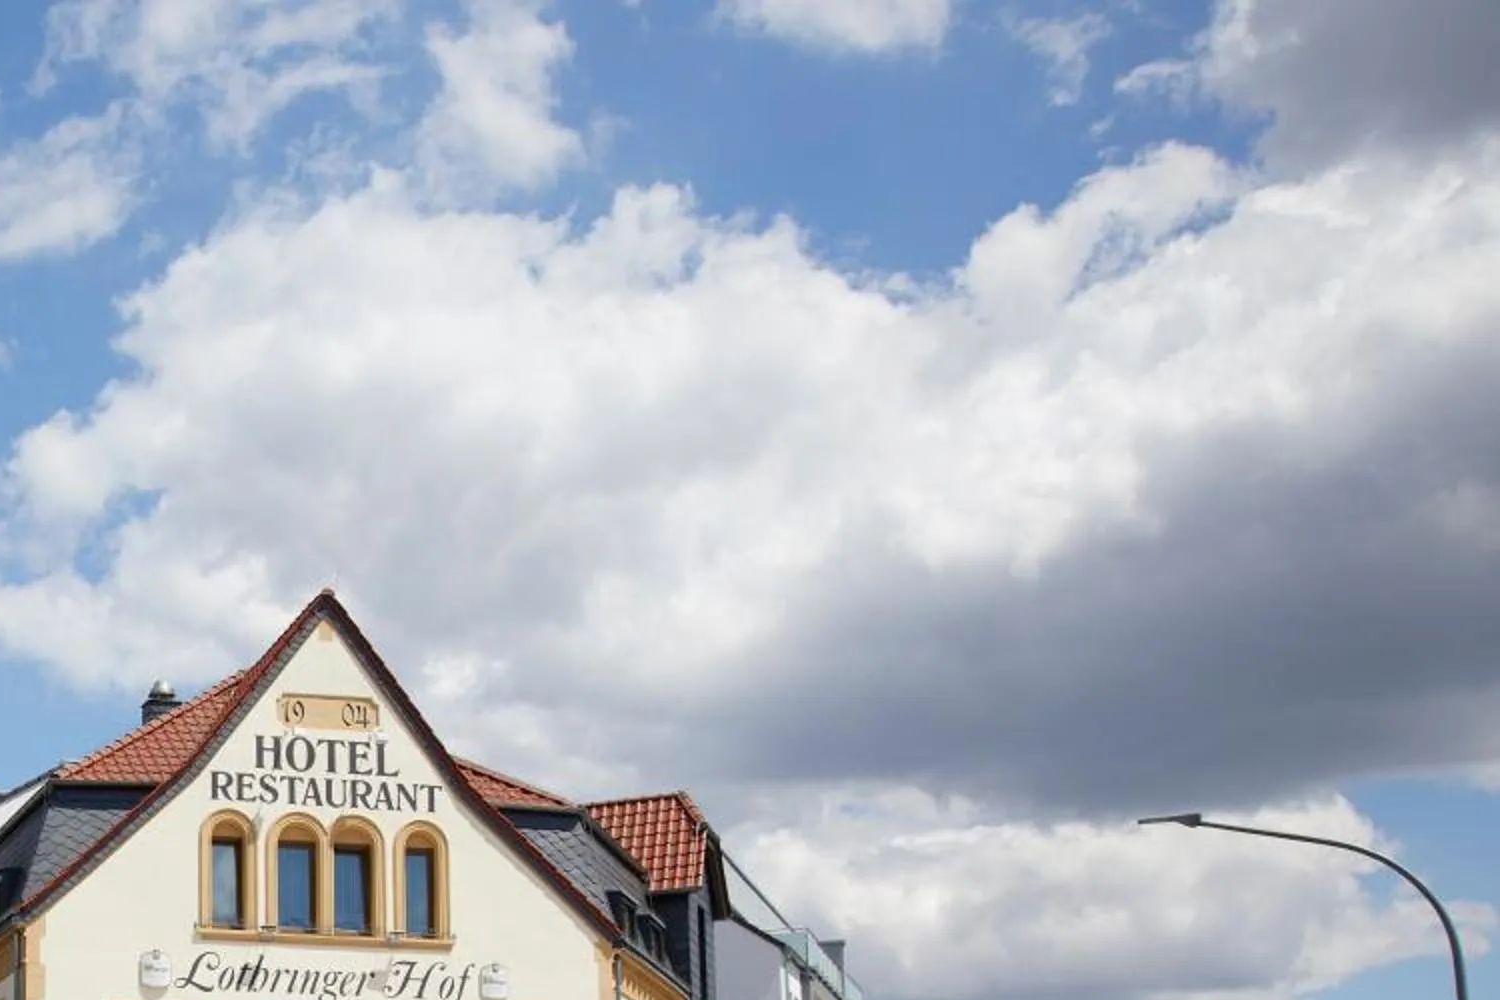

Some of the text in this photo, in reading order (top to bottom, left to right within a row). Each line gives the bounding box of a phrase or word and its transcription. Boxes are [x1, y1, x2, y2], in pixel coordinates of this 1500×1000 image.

[283, 700, 371, 728] 19 04
[255, 735, 400, 777] HOTEL
[210, 771, 443, 813] RESTAURANT
